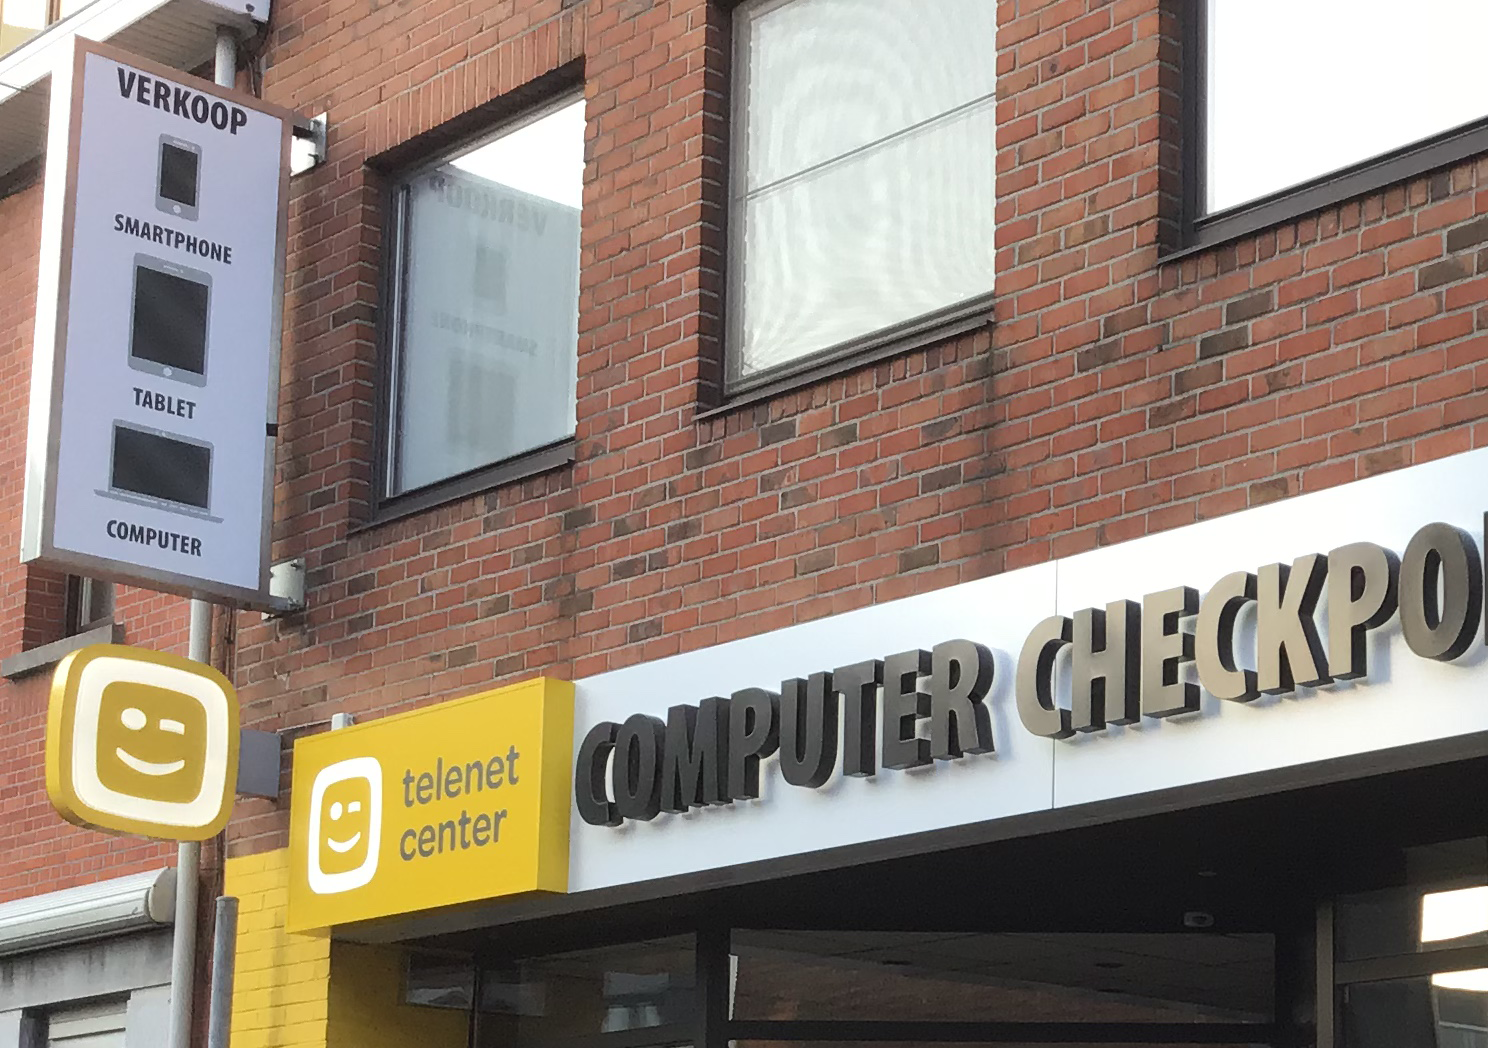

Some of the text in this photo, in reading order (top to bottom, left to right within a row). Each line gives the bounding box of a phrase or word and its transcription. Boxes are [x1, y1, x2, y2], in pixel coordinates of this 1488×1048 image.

[117, 67, 247, 135] VERKOOP
[114, 214, 232, 264] SMARTPHONE
[133, 387, 196, 419] TABLET
[107, 520, 202, 557] COMPUTER
[576, 639, 995, 827] COMPUTER
[402, 745, 520, 808] telenet
[400, 808, 508, 861] center
